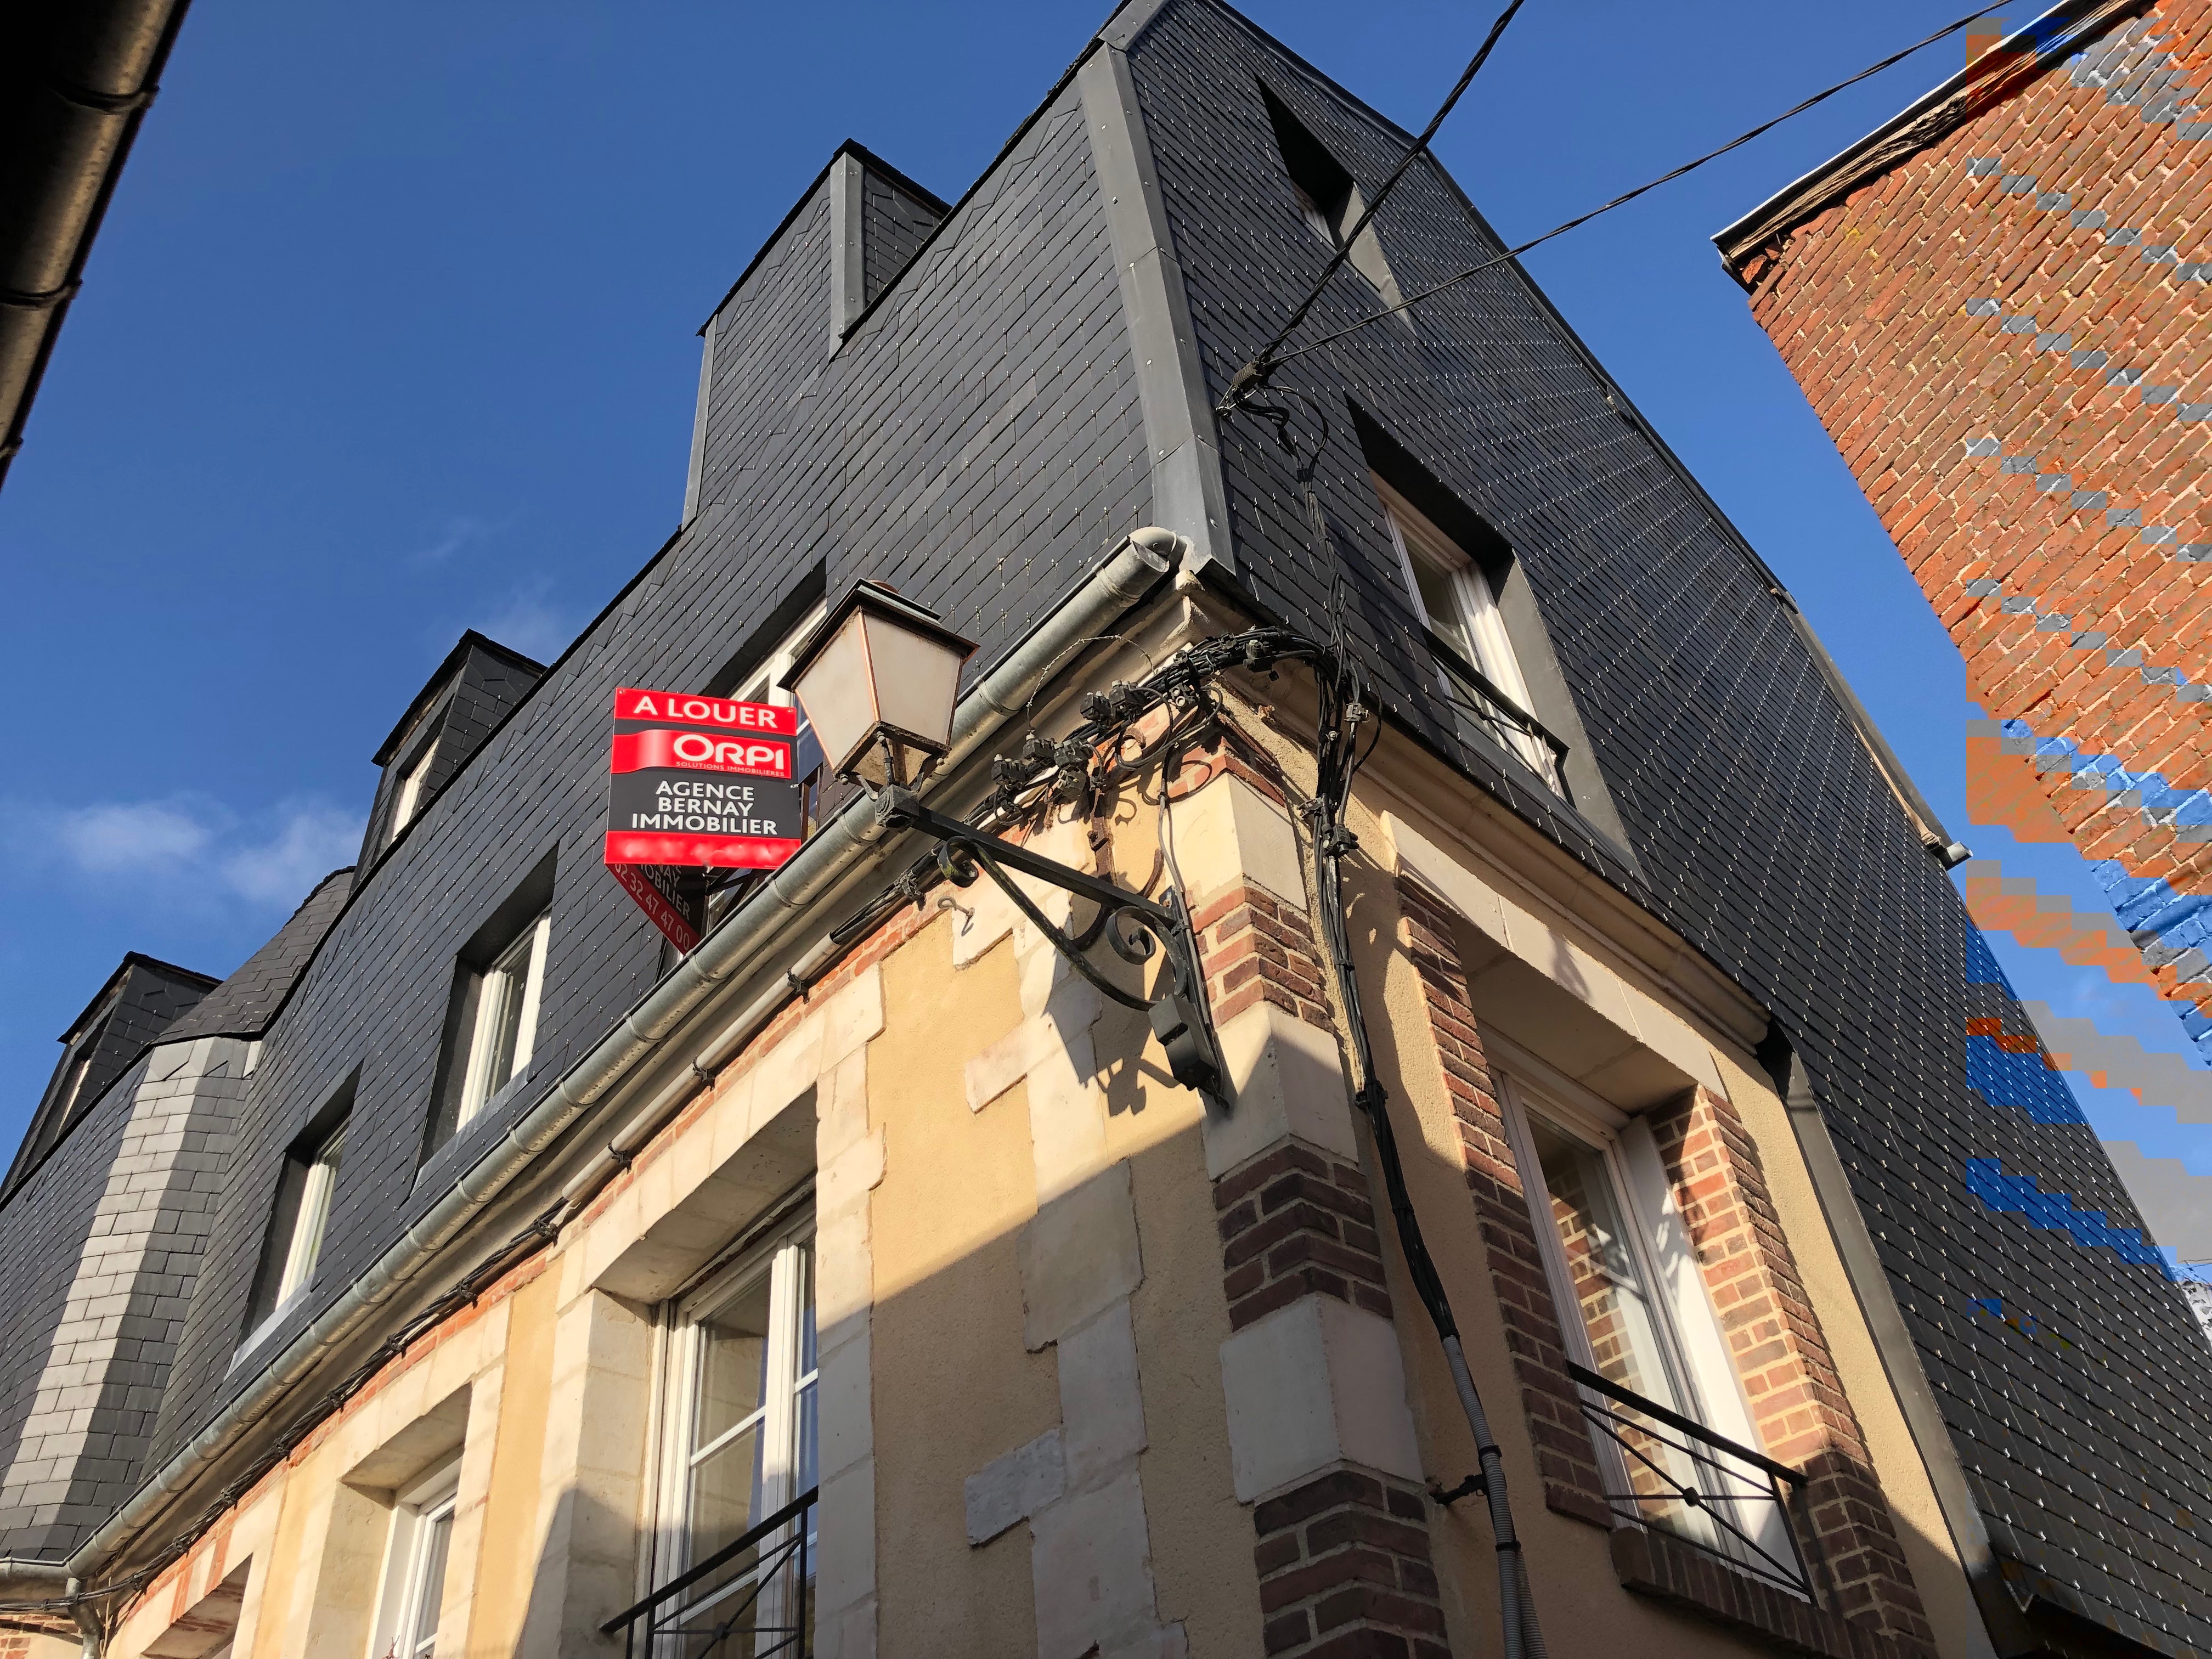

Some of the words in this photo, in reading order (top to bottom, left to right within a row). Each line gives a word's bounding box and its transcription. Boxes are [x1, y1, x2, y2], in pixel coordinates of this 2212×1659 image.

[634, 696, 658, 715] A
[668, 698, 778, 728] LOUER
[674, 734, 784, 770] ORPI
[676, 761, 724, 770] SOLUTIONS
[727, 765, 785, 777] IMMOBILIERES
[655, 780, 754, 801] AGENCE
[658, 797, 754, 817] BERNAY
[631, 813, 778, 835] IMMOBILIER
[630, 872, 643, 900] 32
[645, 893, 659, 915] 47
[661, 911, 674, 932] 47
[676, 925, 690, 950] 00
